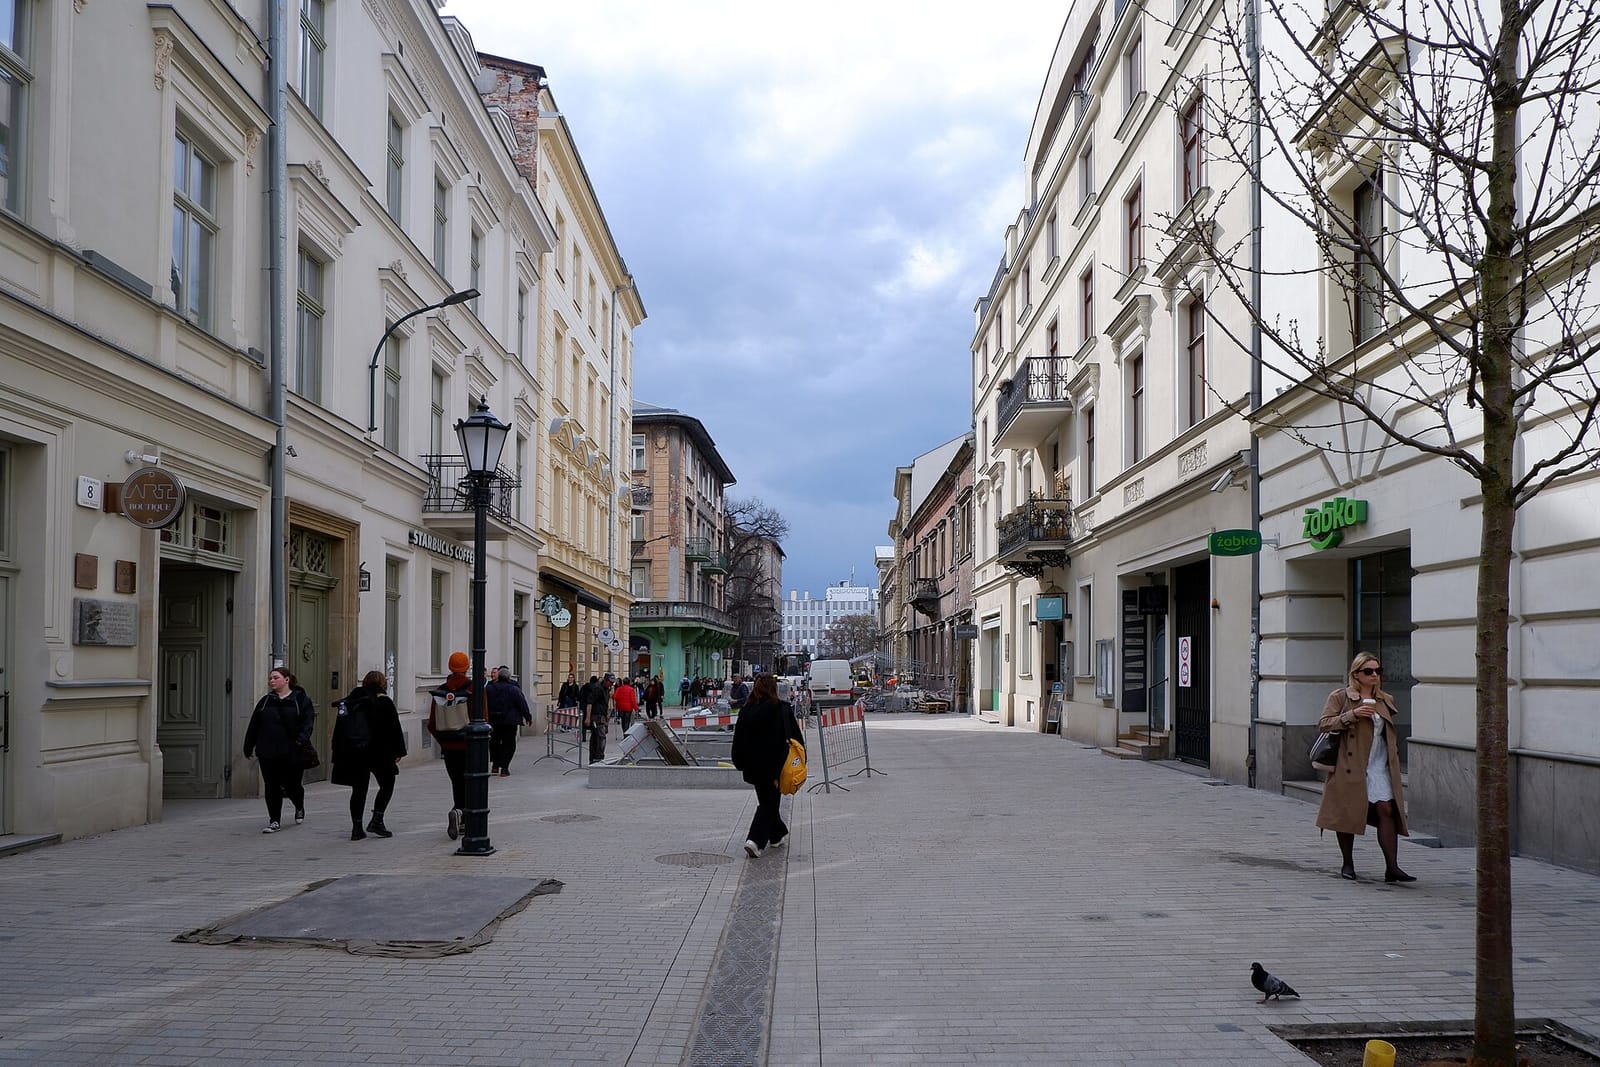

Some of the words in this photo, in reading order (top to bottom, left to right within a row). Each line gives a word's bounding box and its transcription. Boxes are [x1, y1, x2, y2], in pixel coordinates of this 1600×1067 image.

[87, 485, 94, 499] 8
[125, 483, 177, 499] ART
[129, 503, 171, 513] BOUTIQUE
[413, 529, 454, 557] STARBUCKS
[1216, 536, 1258, 547] żabka
